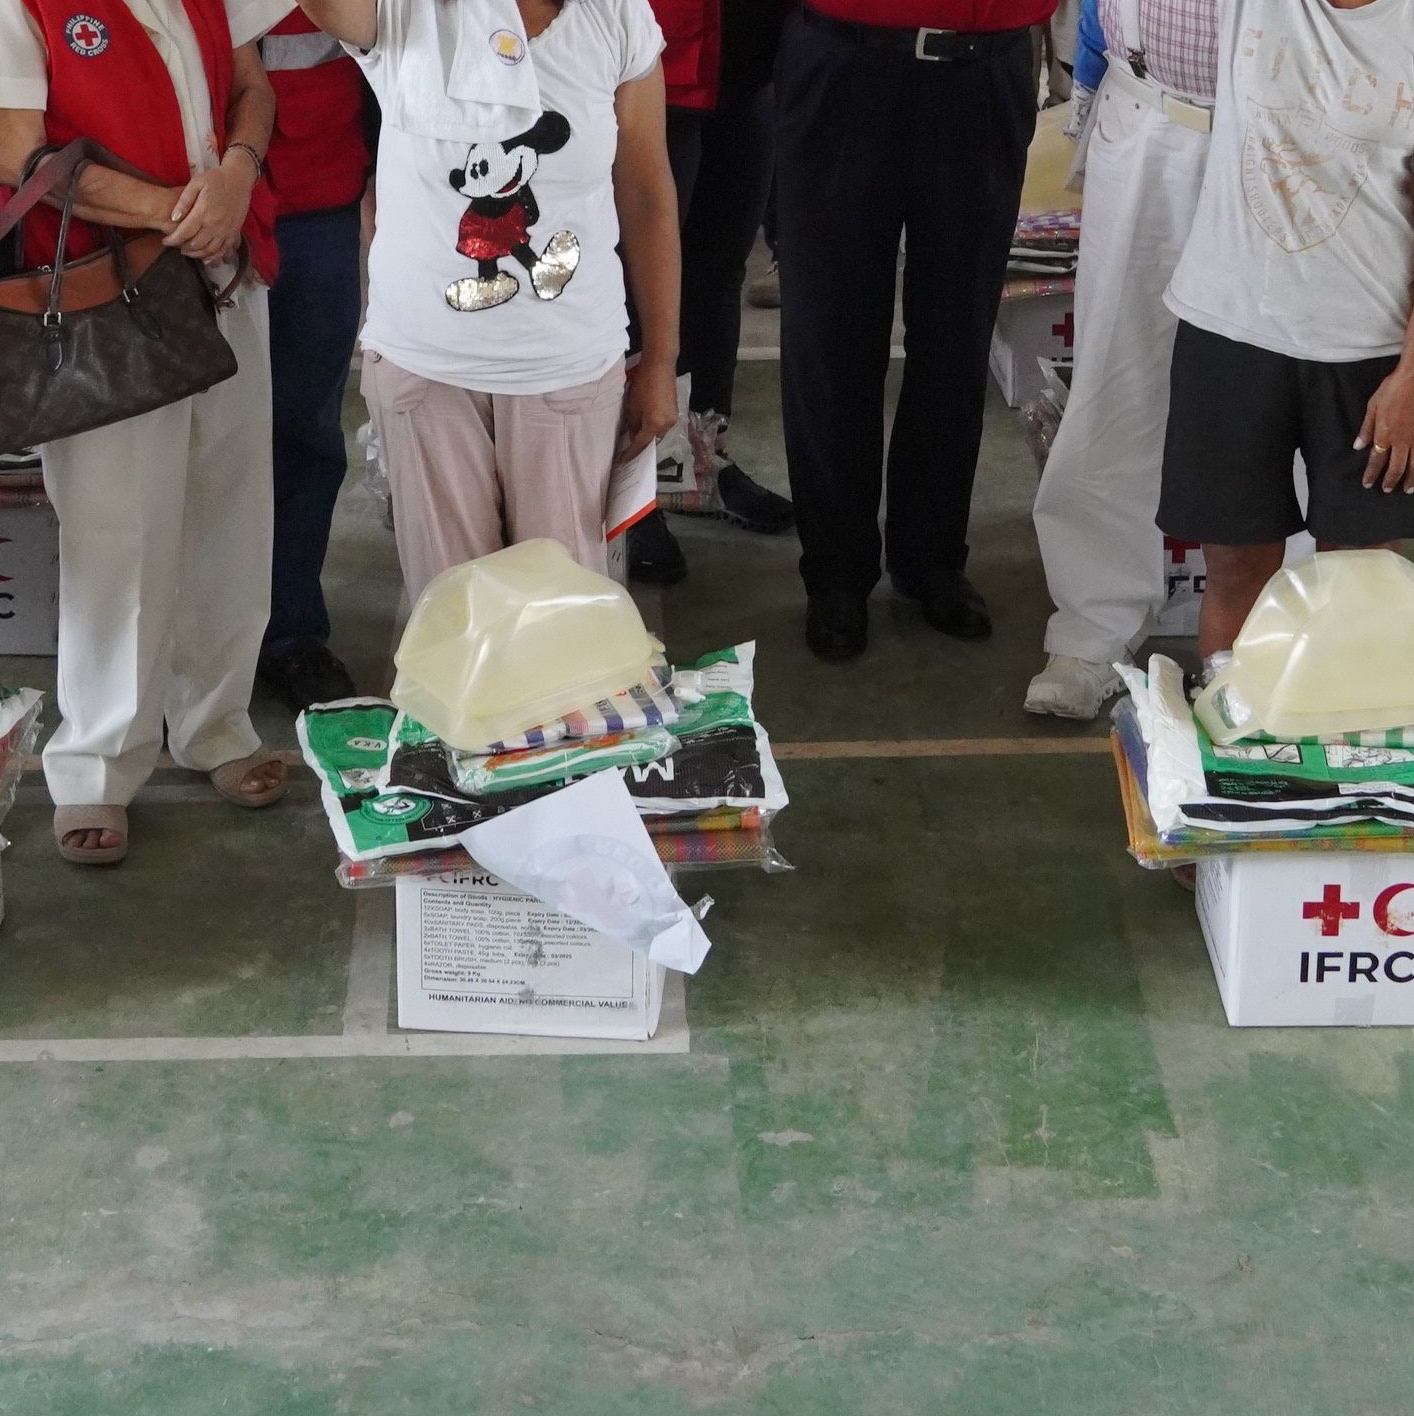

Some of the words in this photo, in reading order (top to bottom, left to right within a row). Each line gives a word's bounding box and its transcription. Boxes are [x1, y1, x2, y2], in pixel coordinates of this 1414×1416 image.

[65, 14, 105, 34] PHILIPPINE
[69, 42, 86, 56] RED
[87, 38, 109, 57] CROSS
[428, 993, 497, 1005] HUMANITARIAN
[534, 998, 595, 1008] COMMERCIAL
[598, 1000, 628, 1009] VALUE
